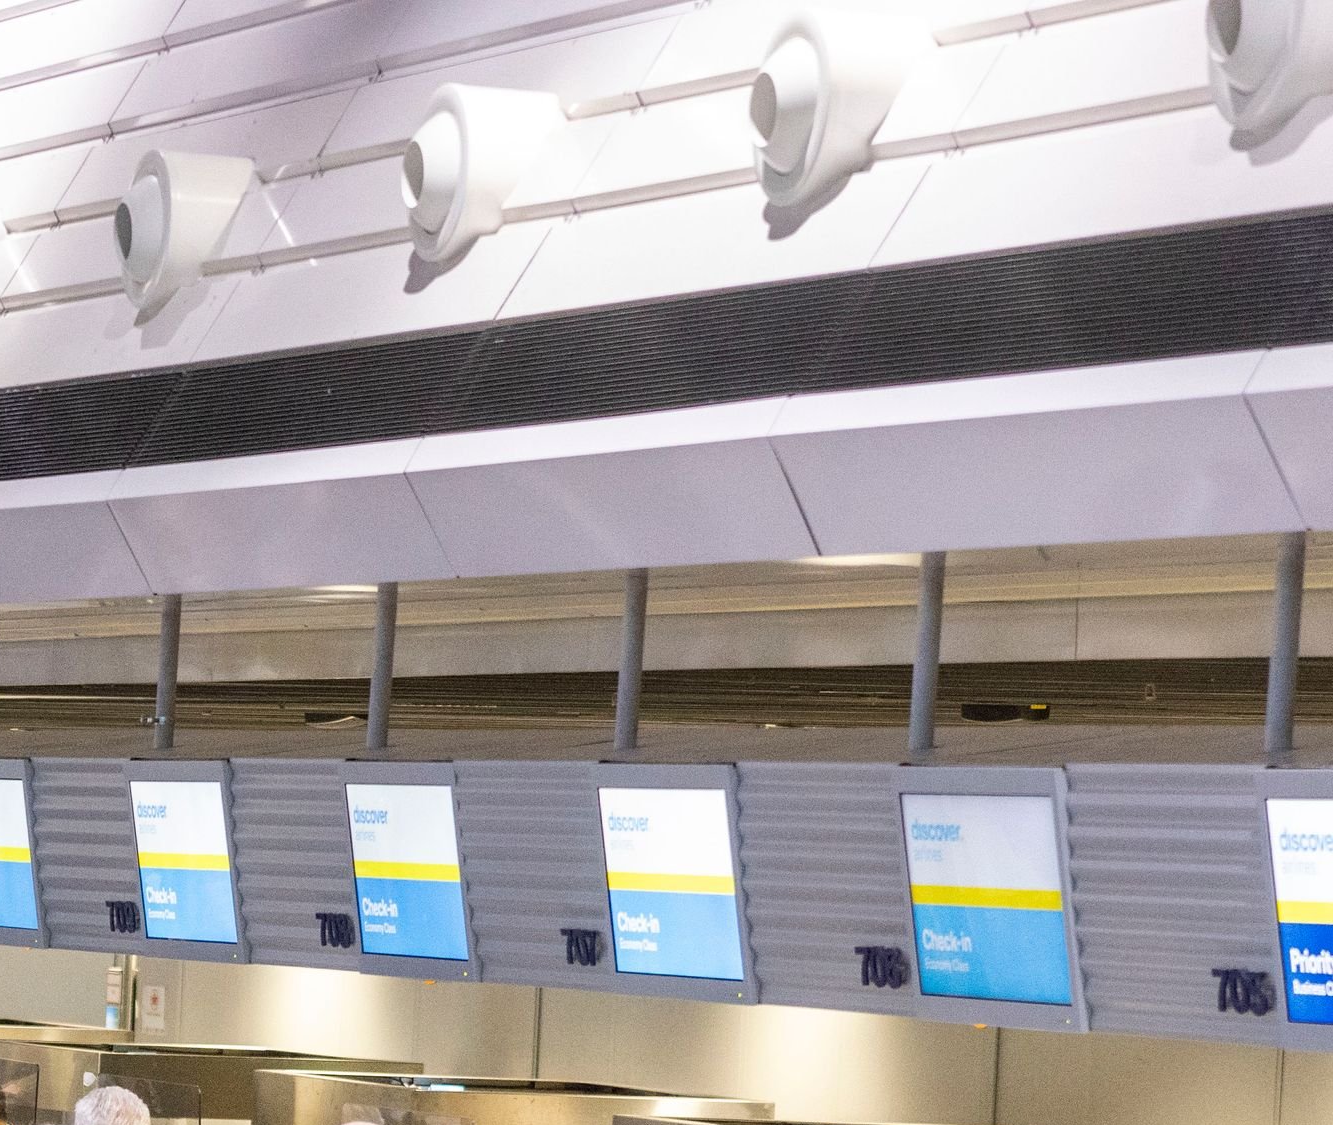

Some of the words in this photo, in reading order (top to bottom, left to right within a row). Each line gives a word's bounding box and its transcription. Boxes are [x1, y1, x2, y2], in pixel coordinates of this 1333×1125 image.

[1280, 828, 1333, 852] discove
[146, 887, 177, 904] Check-in
[362, 897, 398, 918] Check-in
[617, 912, 661, 934] Check-in
[922, 928, 972, 952] Check-in
